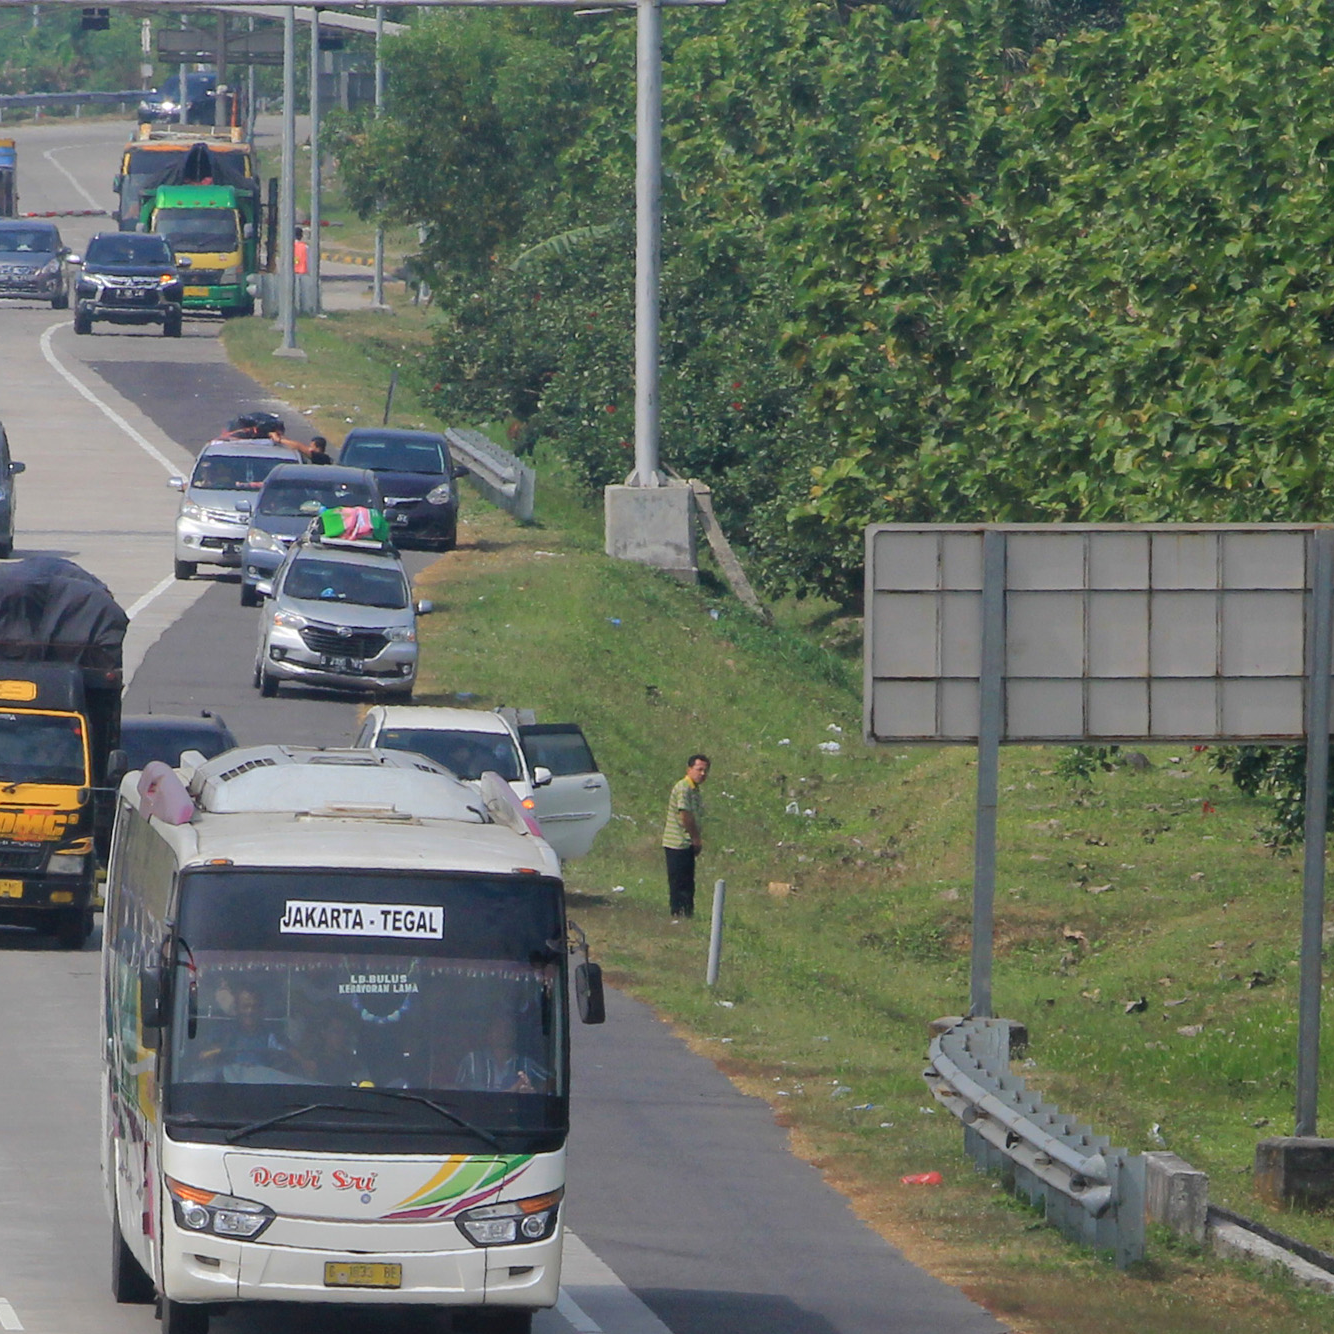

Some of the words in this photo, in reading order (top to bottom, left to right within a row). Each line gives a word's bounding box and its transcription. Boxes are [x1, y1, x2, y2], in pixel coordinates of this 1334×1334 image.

[283, 906, 364, 930] JAKARTA
[381, 909, 438, 933] TEGAL
[338, 984, 390, 994] KEBAYORAN
[393, 983, 419, 993] LAMA
[249, 1166, 323, 1190] Dewi
[331, 1169, 378, 1193] Sri
